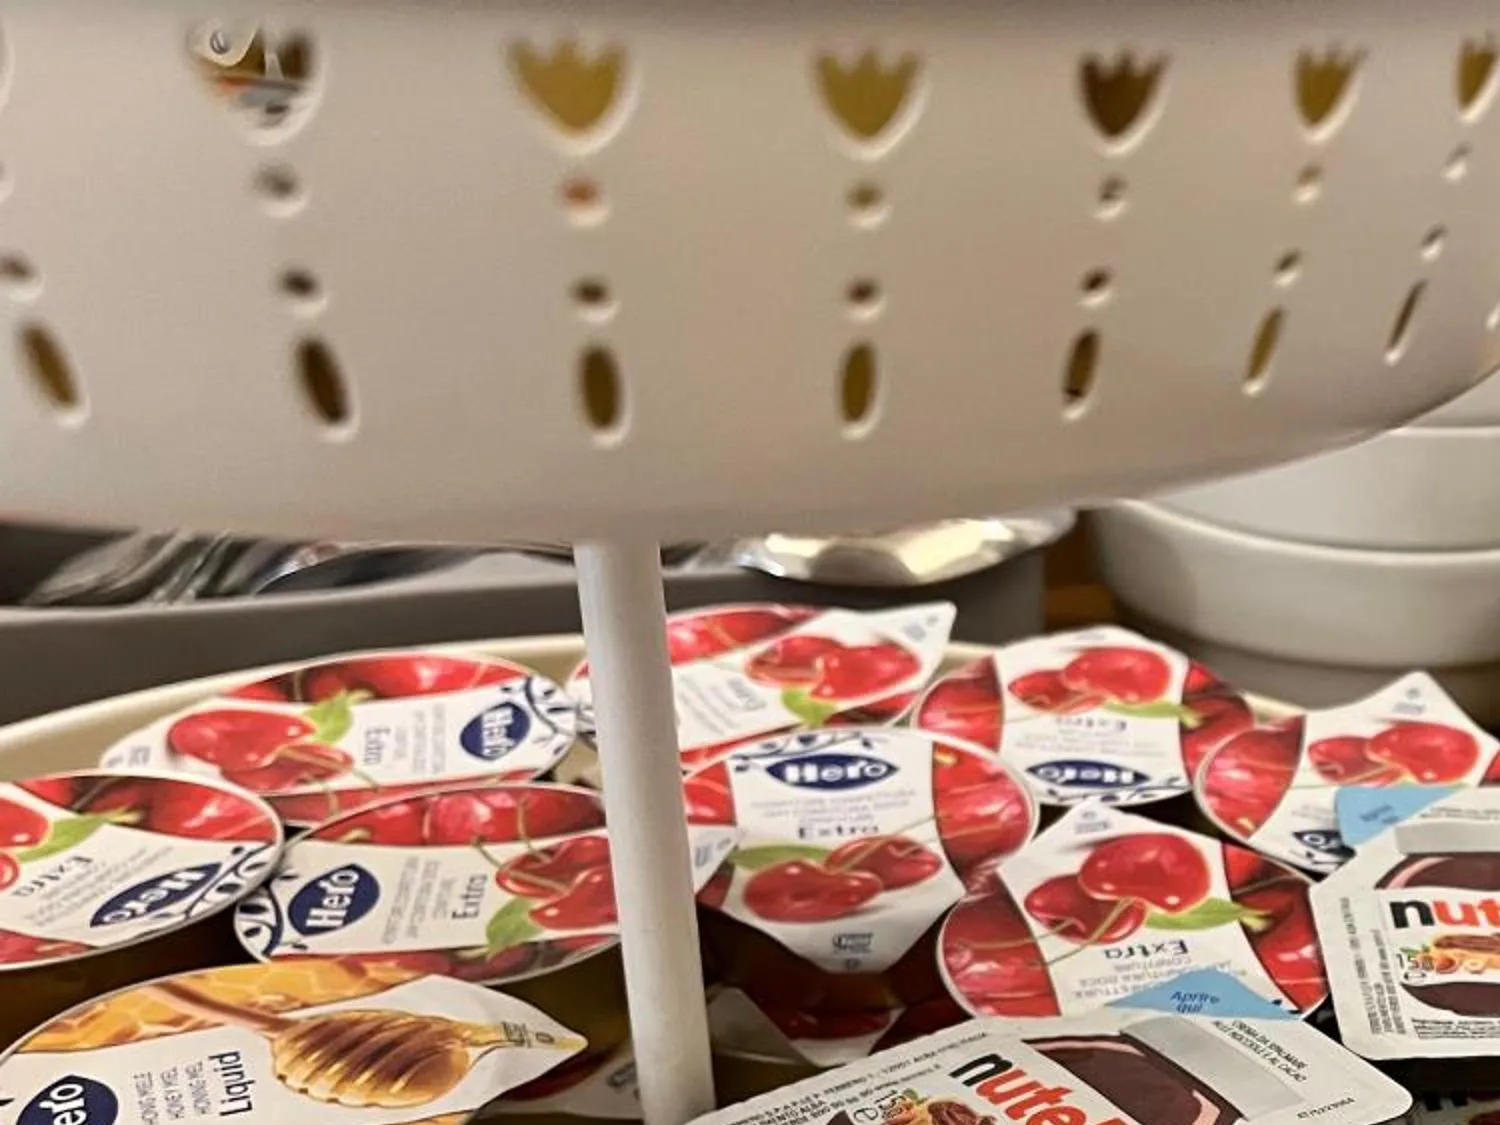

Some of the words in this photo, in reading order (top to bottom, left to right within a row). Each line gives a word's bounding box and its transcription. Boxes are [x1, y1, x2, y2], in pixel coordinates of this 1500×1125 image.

[783, 759, 890, 783] Hero
[1037, 764, 1135, 785] Hero
[798, 824, 880, 840] Extra
[304, 867, 362, 929] Hero
[452, 874, 488, 921] Extra
[1103, 938, 1190, 961] Extra
[208, 1050, 257, 1117] Liquid
